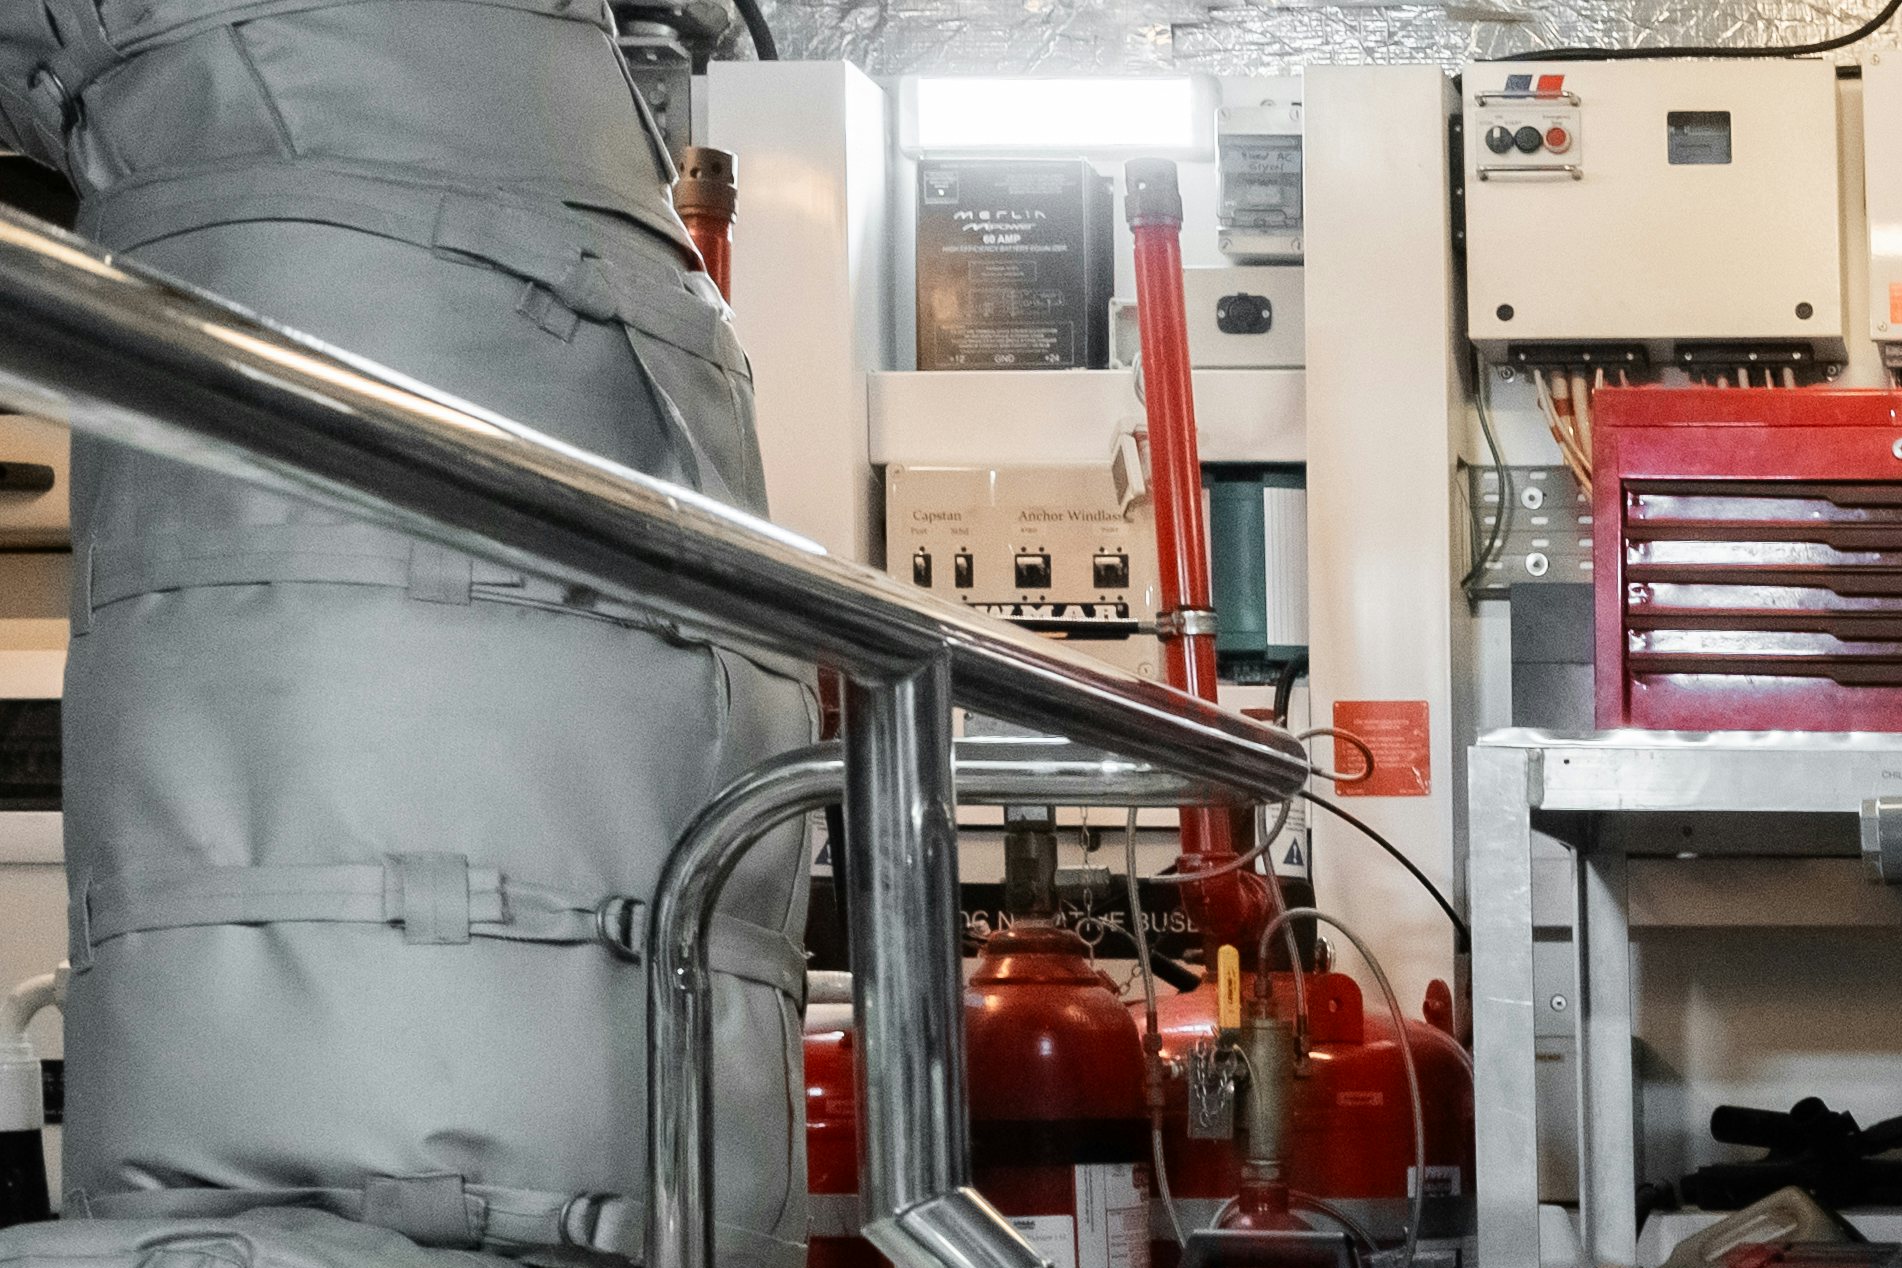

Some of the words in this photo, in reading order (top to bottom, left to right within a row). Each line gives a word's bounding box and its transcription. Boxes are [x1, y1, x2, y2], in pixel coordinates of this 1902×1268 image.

[983, 234, 996, 244] 60
[996, 234, 1022, 244] AMP
[993, 353, 1016, 363] GND
[912, 509, 963, 524] Capstan
[1017, 509, 1064, 522] Anchor
